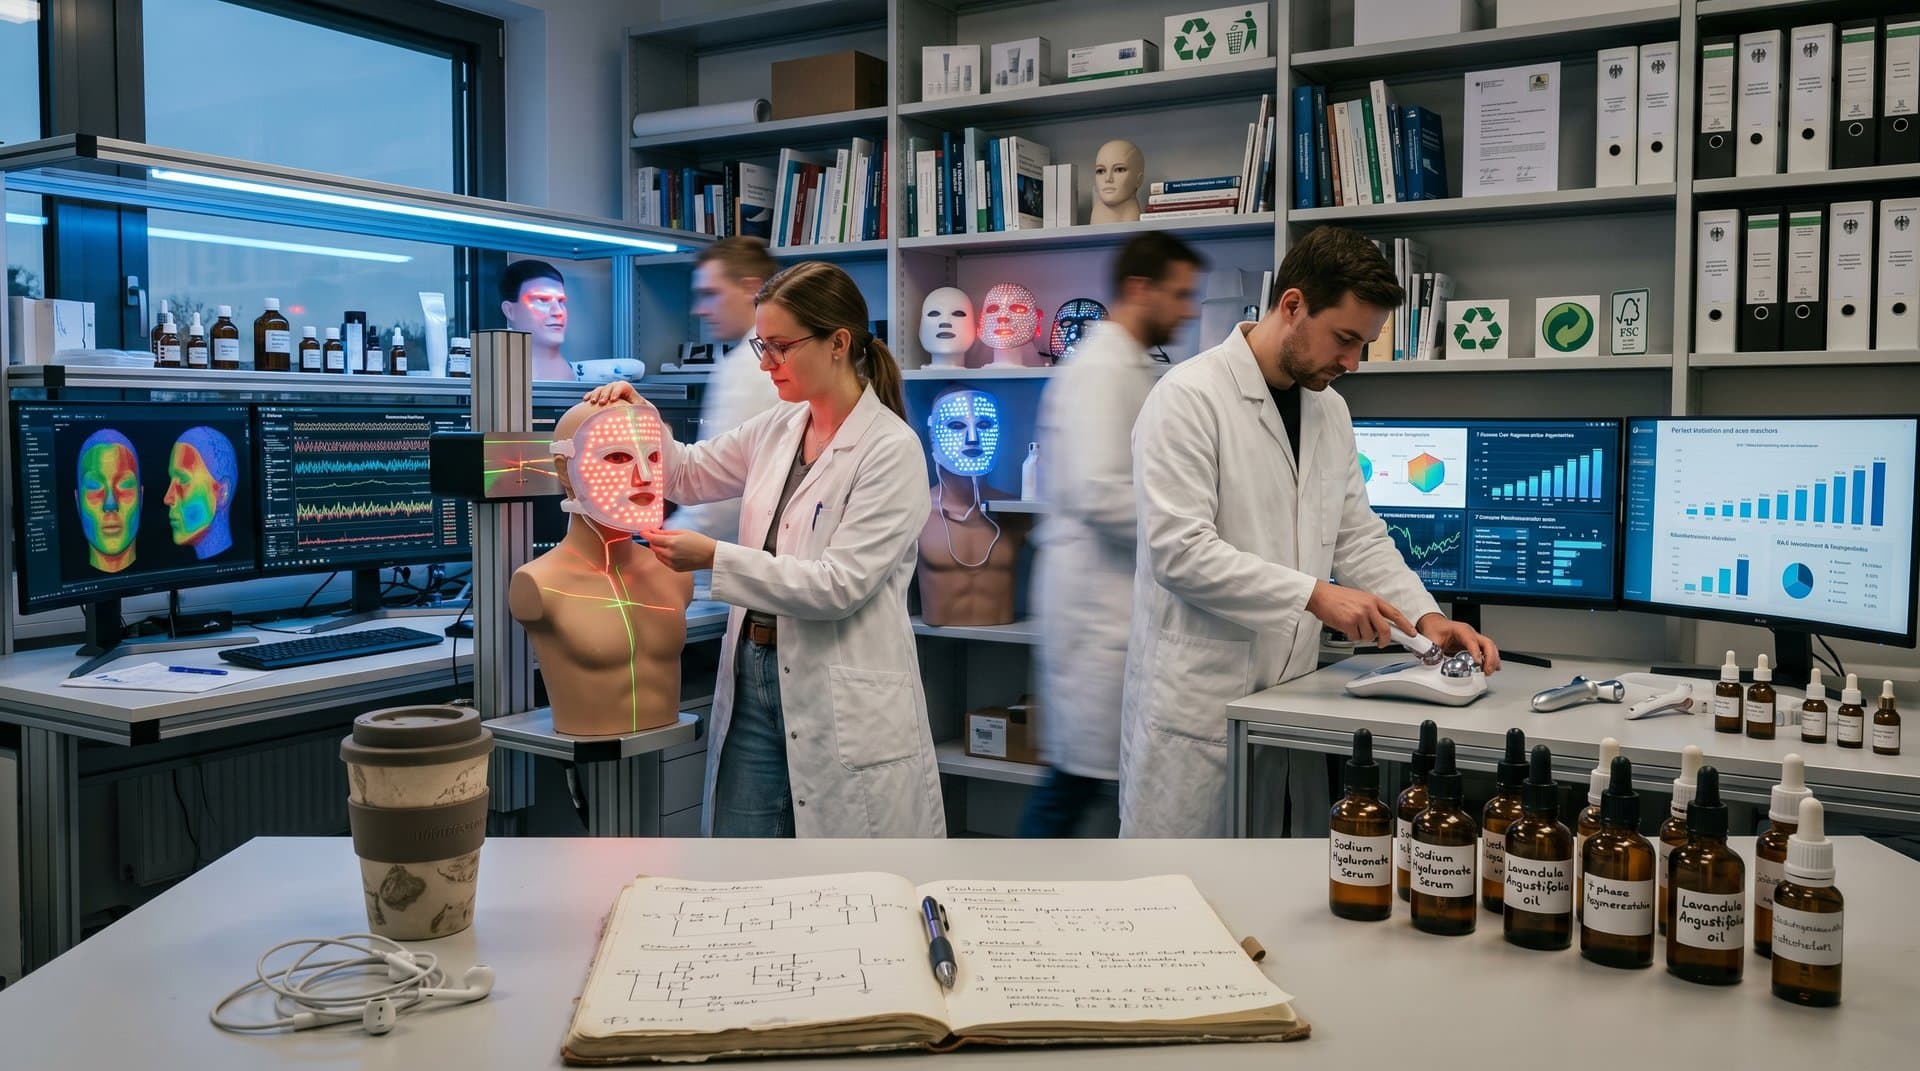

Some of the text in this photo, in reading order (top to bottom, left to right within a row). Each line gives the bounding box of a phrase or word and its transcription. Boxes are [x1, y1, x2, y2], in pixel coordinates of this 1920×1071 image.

[1620, 327, 1639, 337] FSC
[1400, 828, 1412, 838] So
[1335, 838, 1373, 852] Sodium
[1333, 851, 1389, 866] Hyaluronate
[1415, 846, 1453, 863] Sodium
[1341, 868, 1374, 879] Serum
[1413, 861, 1471, 876] Hyaluronate
[1508, 860, 1563, 878] Lavandula
[1420, 876, 1454, 889] Serum
[1506, 874, 1569, 895] Angustifolia
[1597, 884, 1630, 897] phase
[1523, 896, 1540, 906] oil
[1682, 895, 1742, 912] Lavandula
[1708, 931, 1724, 942] oil
